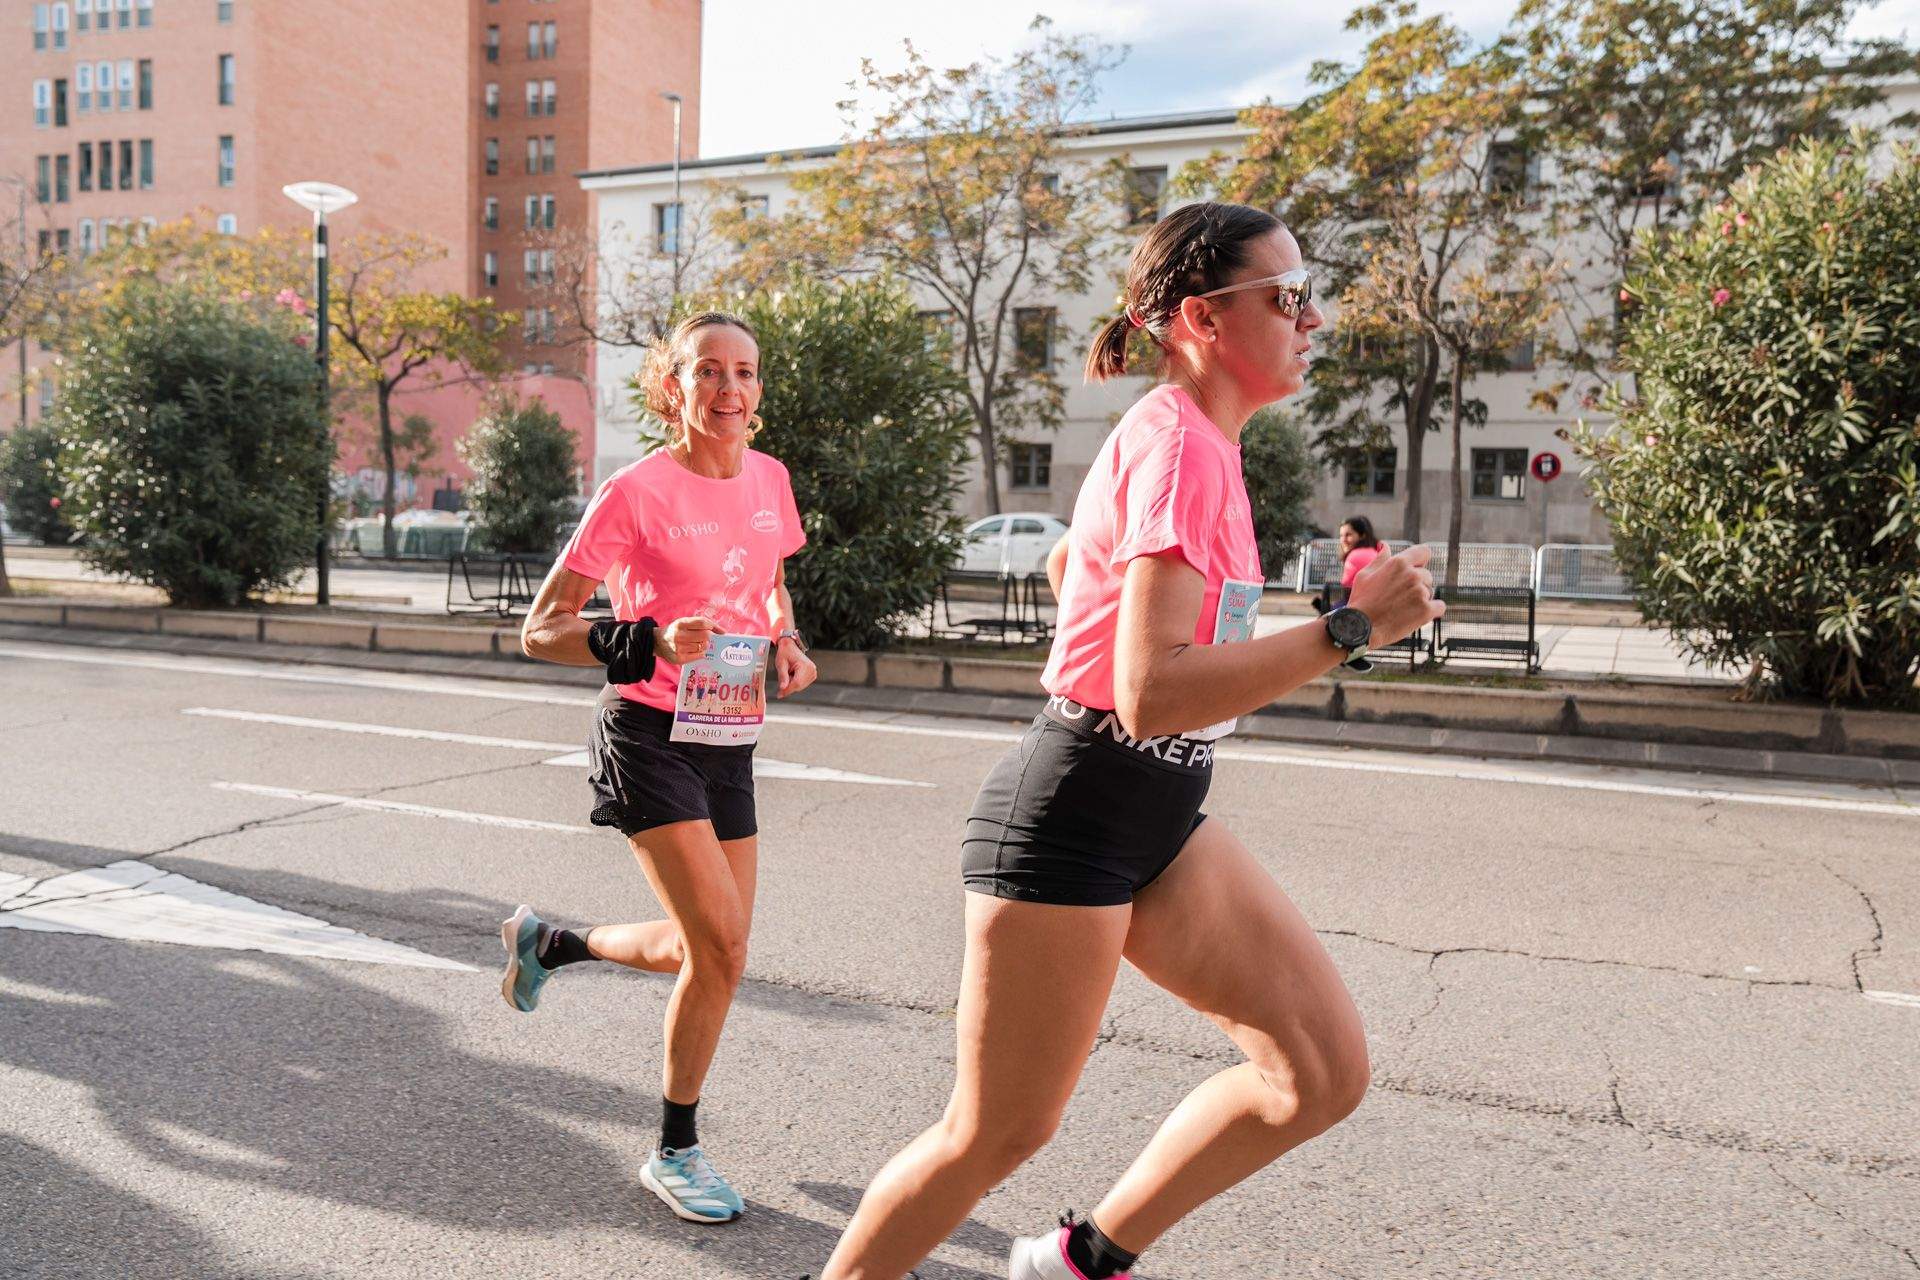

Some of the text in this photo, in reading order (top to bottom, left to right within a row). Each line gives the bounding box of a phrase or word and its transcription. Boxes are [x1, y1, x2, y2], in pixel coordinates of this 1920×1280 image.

[669, 522, 719, 539] OYSHO
[718, 684, 750, 702] 016
[688, 713, 713, 722] CARRERA
[722, 706, 743, 715] 13152
[685, 727, 722, 738] OYSHO
[1187, 744, 1215, 768] PR
